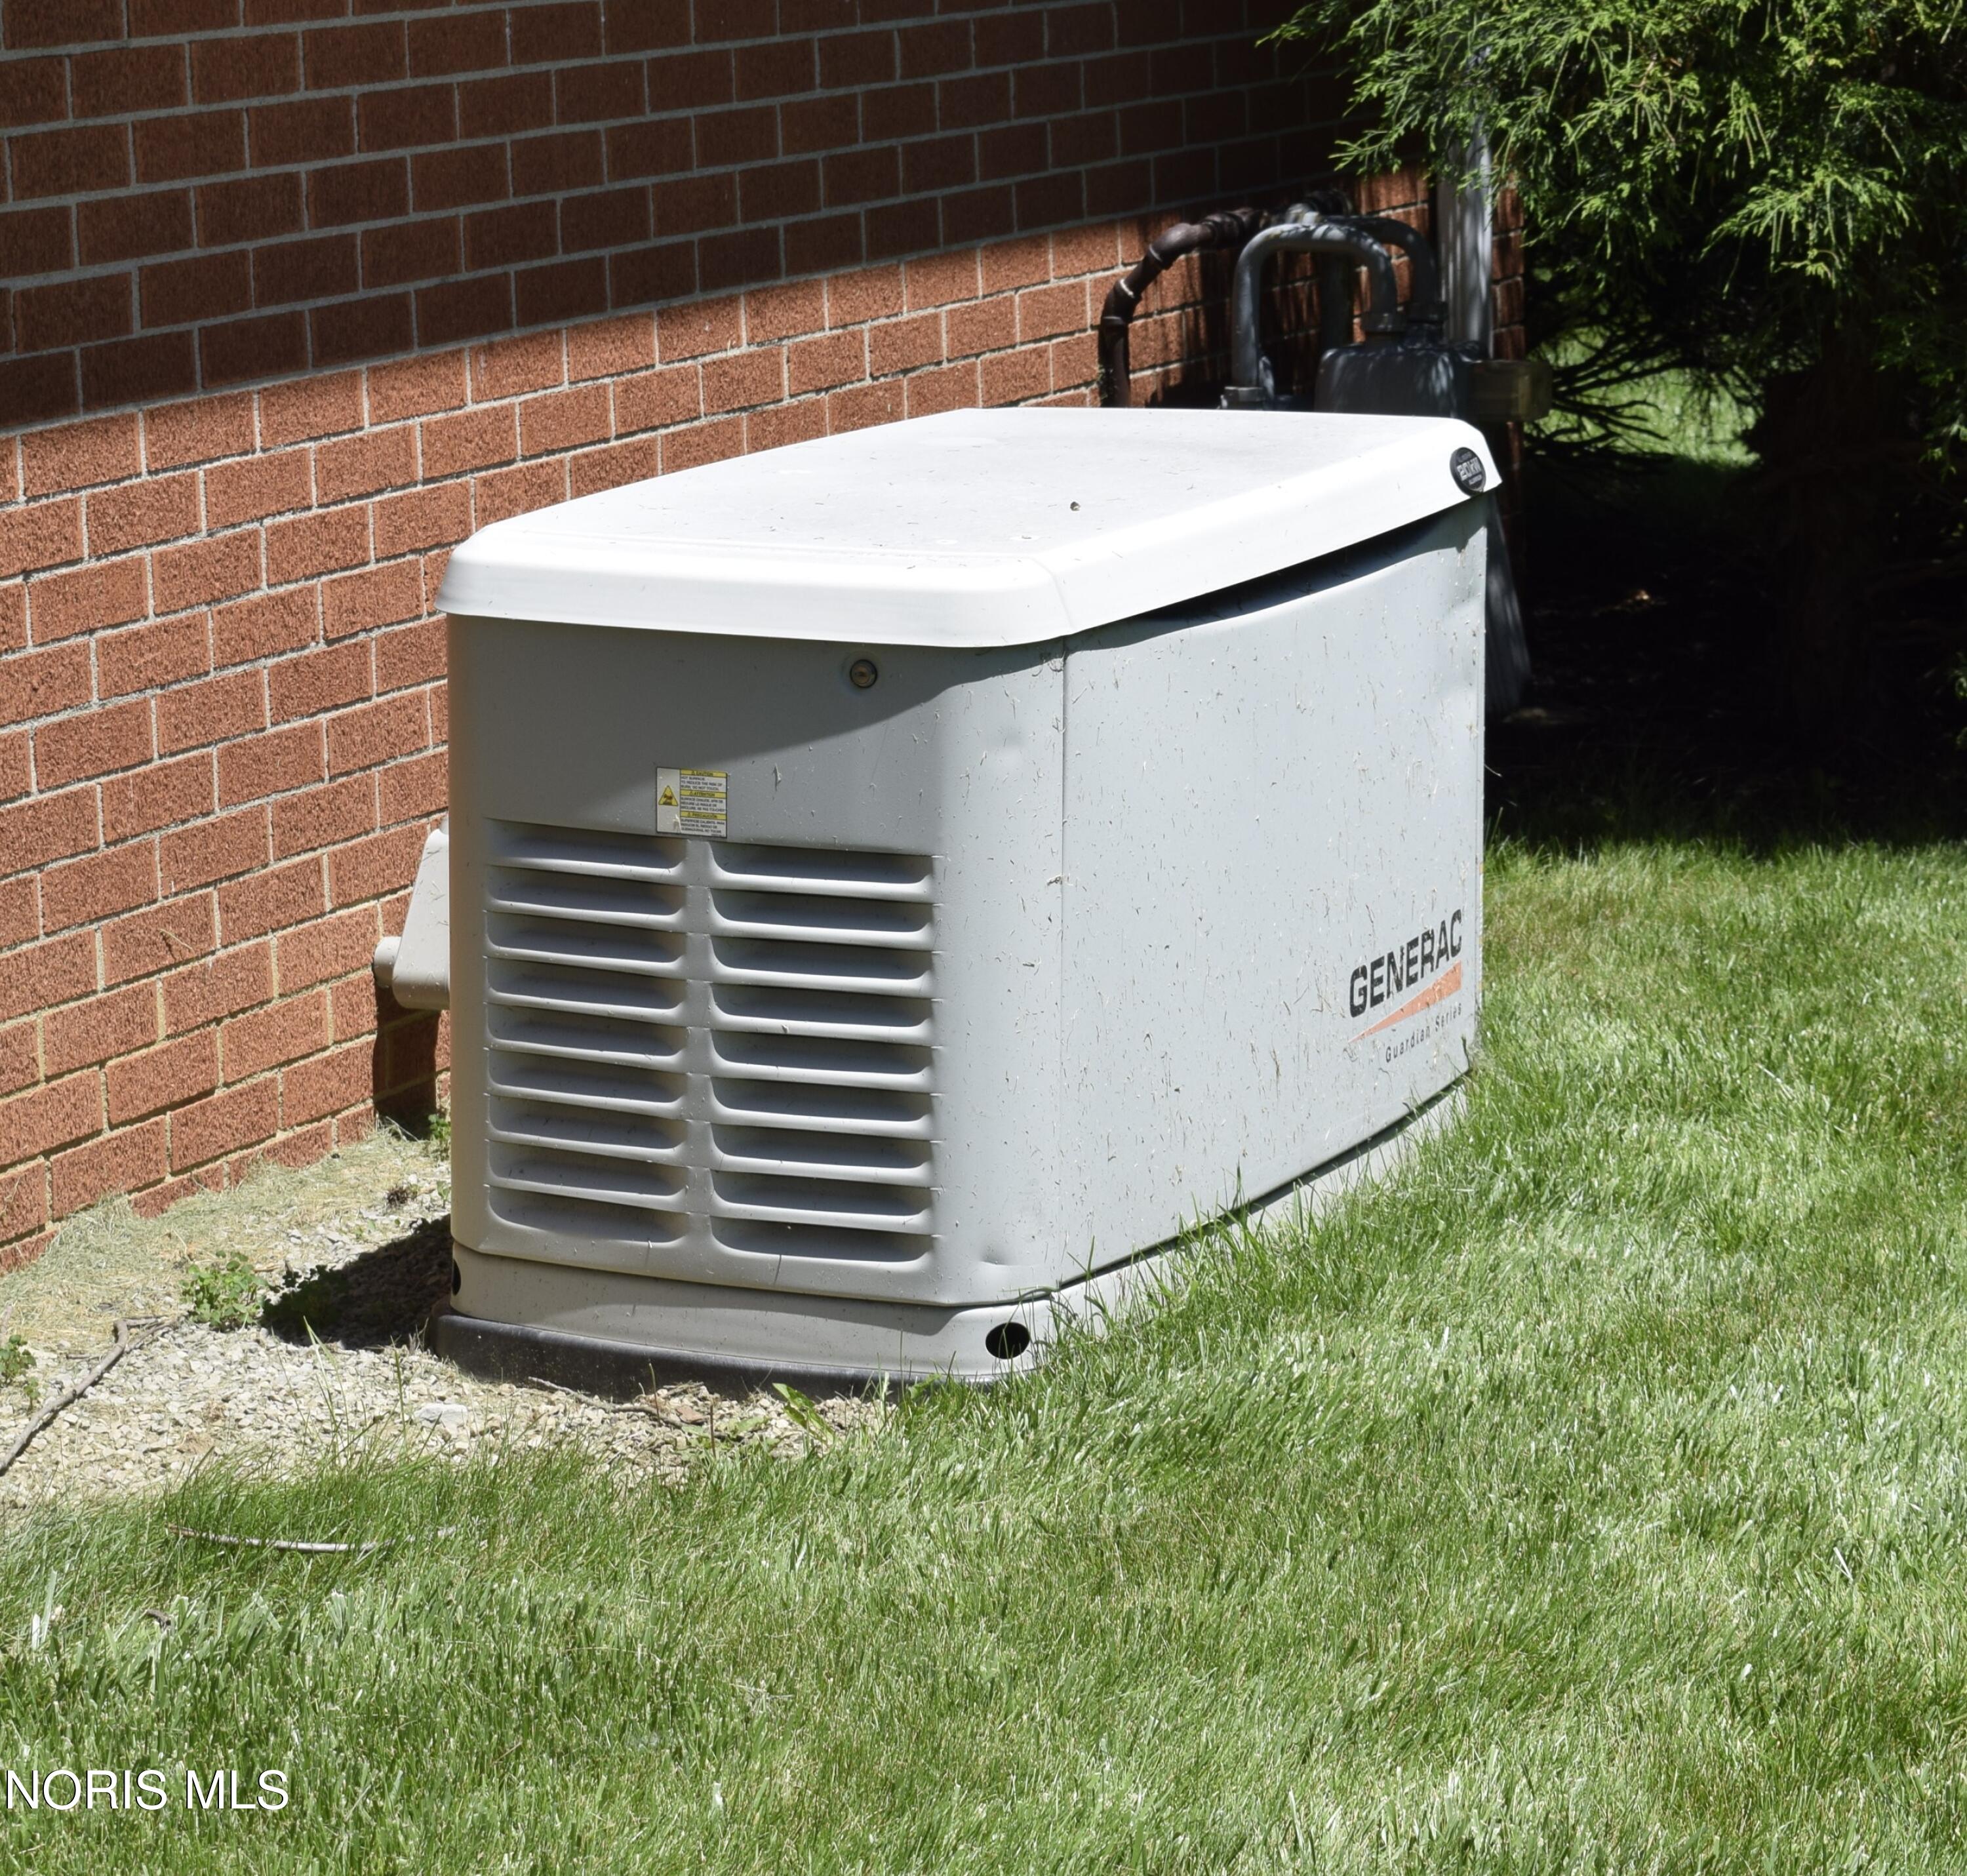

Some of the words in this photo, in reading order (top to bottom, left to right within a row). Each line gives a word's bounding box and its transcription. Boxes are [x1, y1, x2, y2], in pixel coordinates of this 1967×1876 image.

[1349, 909, 1462, 1018] GENERAC
[1385, 1026, 1430, 1063] Guardian
[1435, 1003, 1461, 1032] Series
